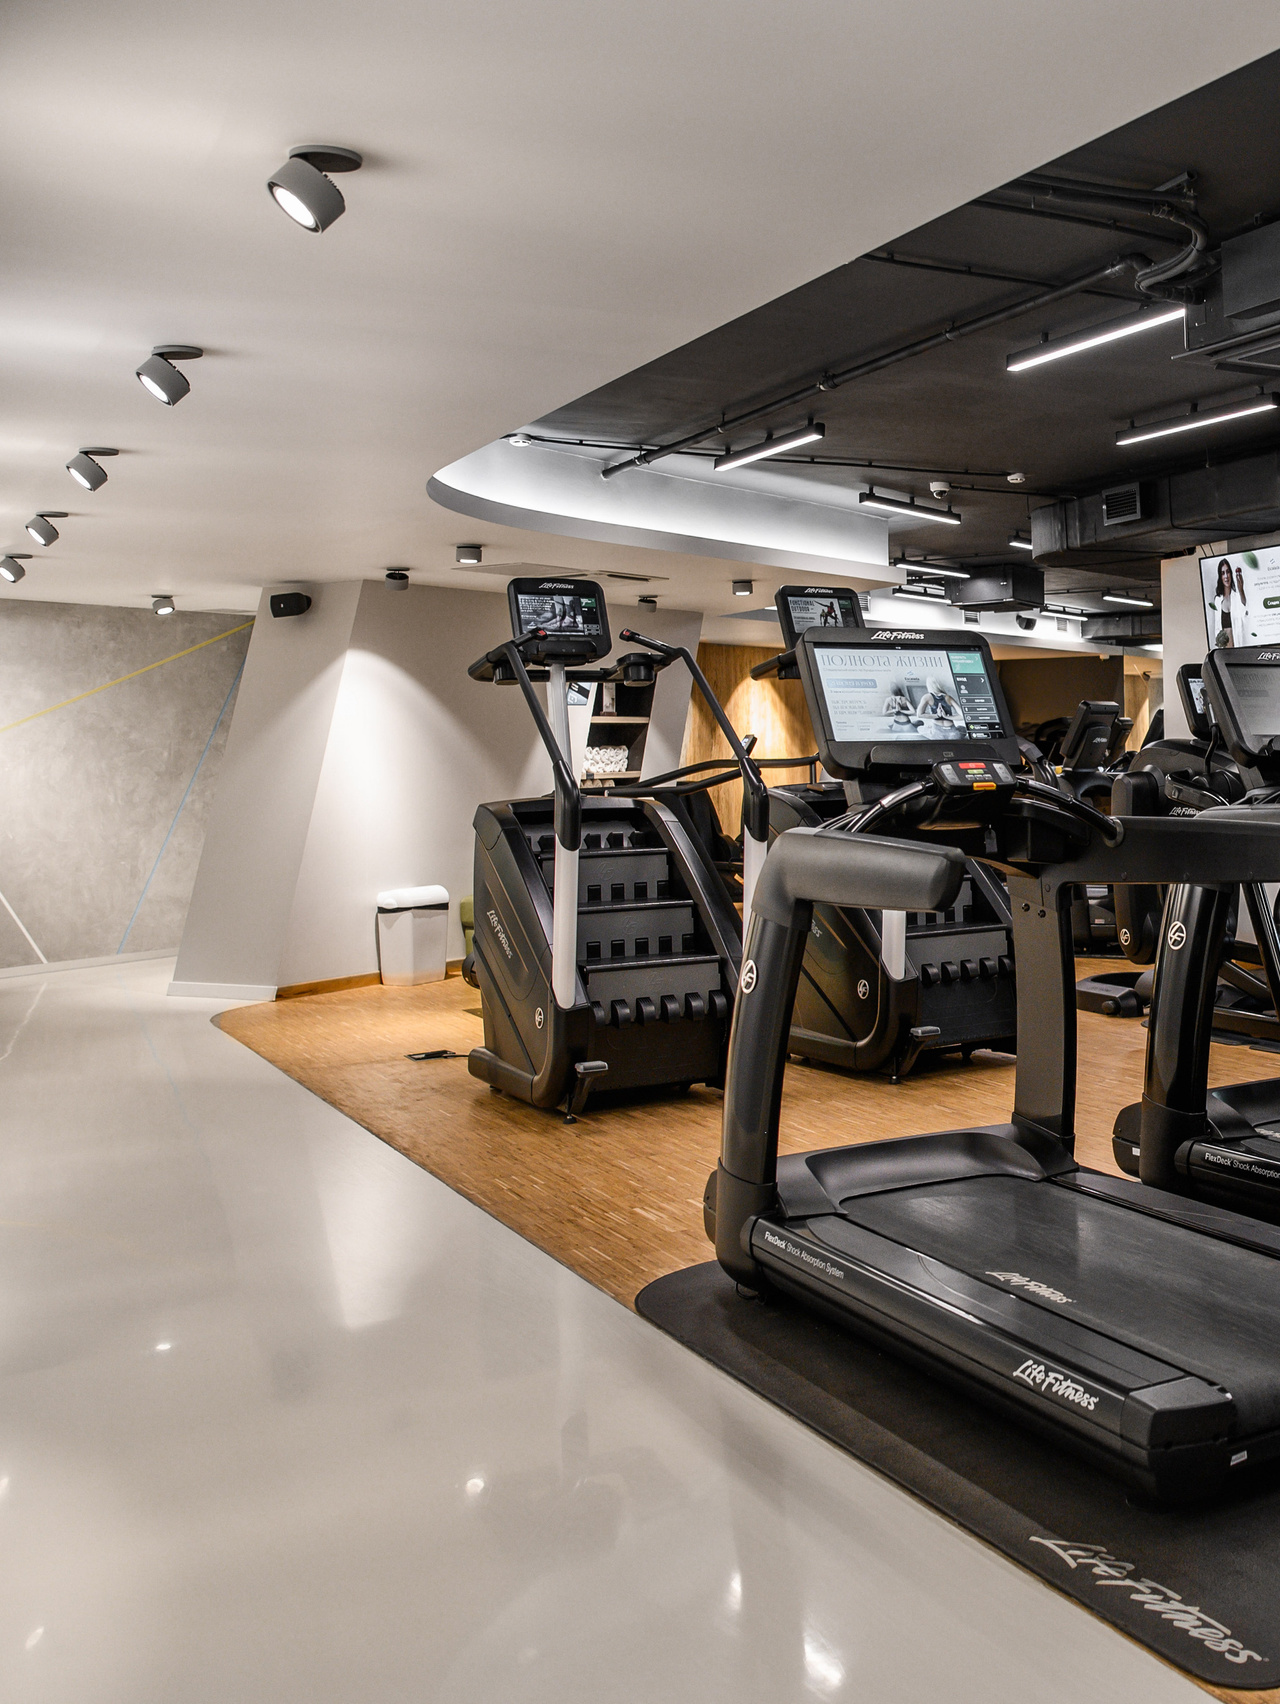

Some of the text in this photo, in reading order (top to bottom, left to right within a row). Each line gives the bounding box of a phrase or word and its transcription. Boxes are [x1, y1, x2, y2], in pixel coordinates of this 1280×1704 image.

[1205, 1152, 1232, 1166] FlexDeck
[1232, 1159, 1250, 1171] Shock
[764, 1231, 844, 1279] FlexDeck Shock Absorption System
